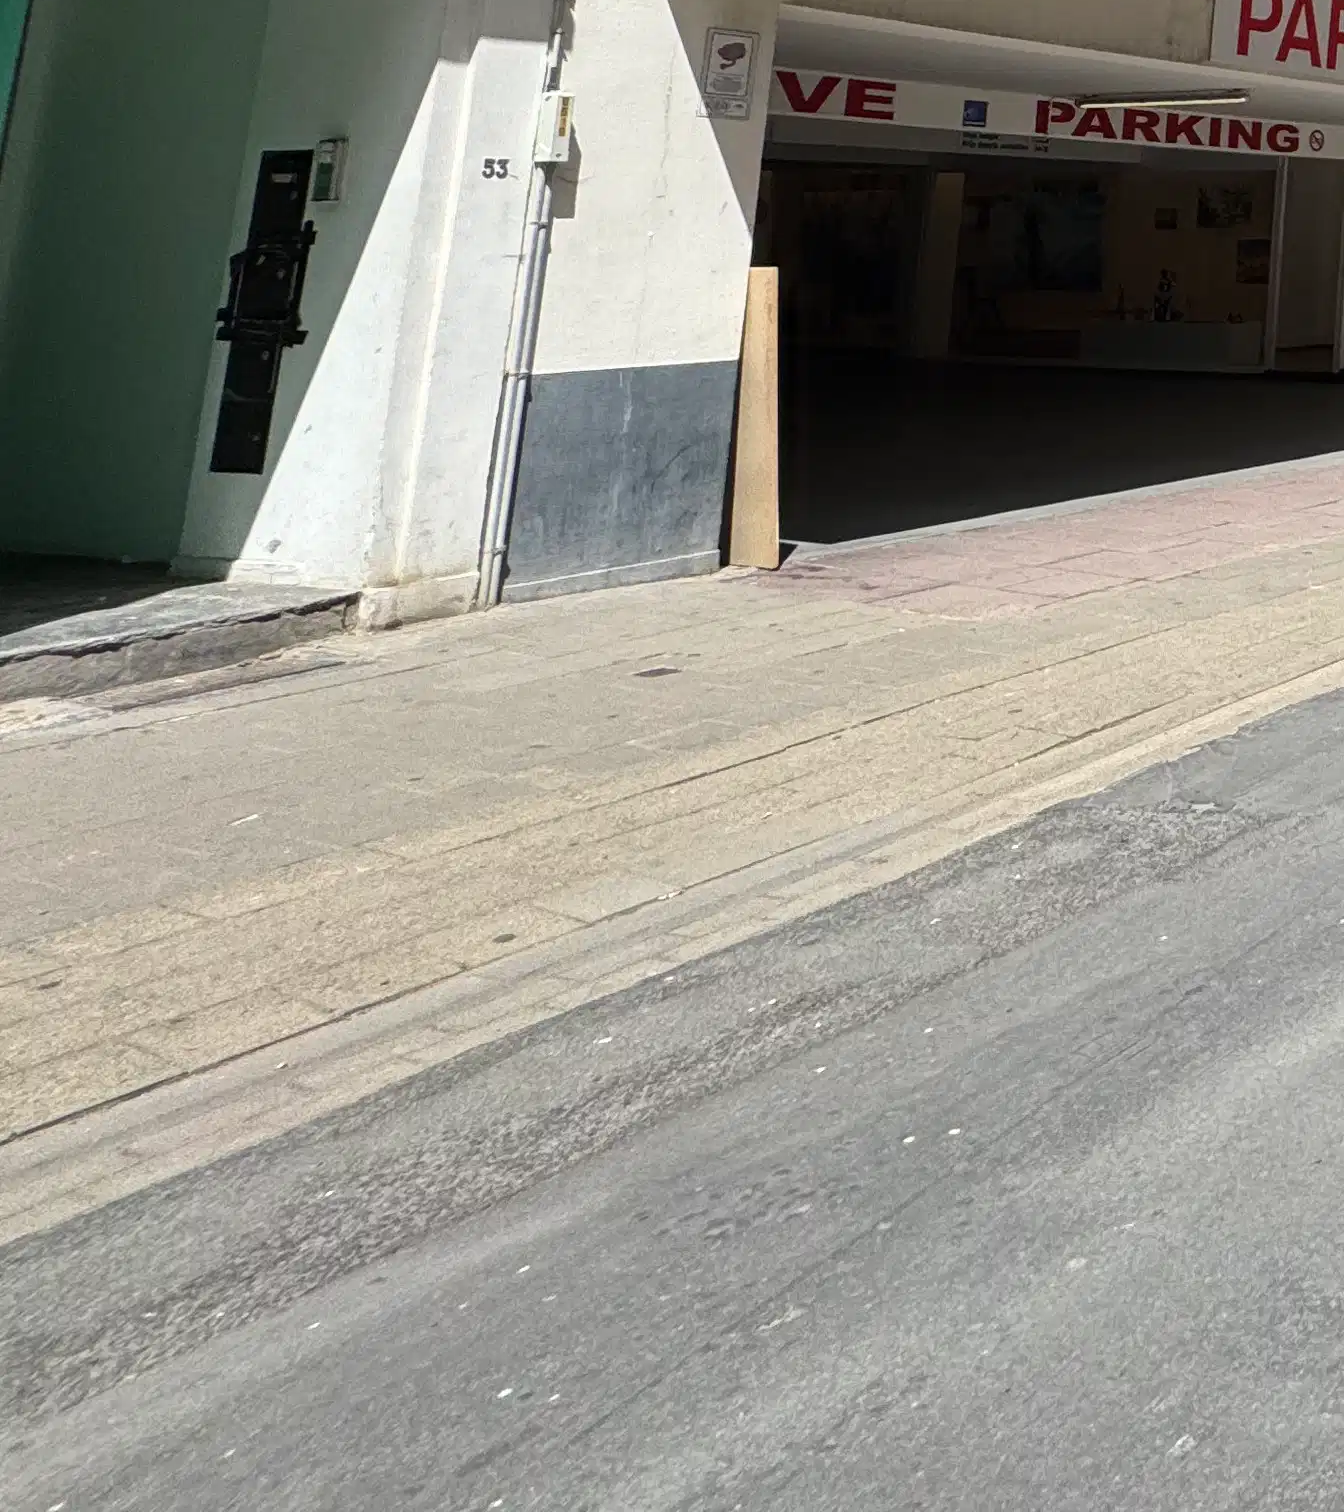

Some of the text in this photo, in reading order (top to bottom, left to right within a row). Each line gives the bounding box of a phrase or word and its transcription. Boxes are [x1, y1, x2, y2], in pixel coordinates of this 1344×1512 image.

[775, 70, 897, 121] VE
[1034, 99, 1300, 153] PARKING
[481, 158, 510, 179] 53
